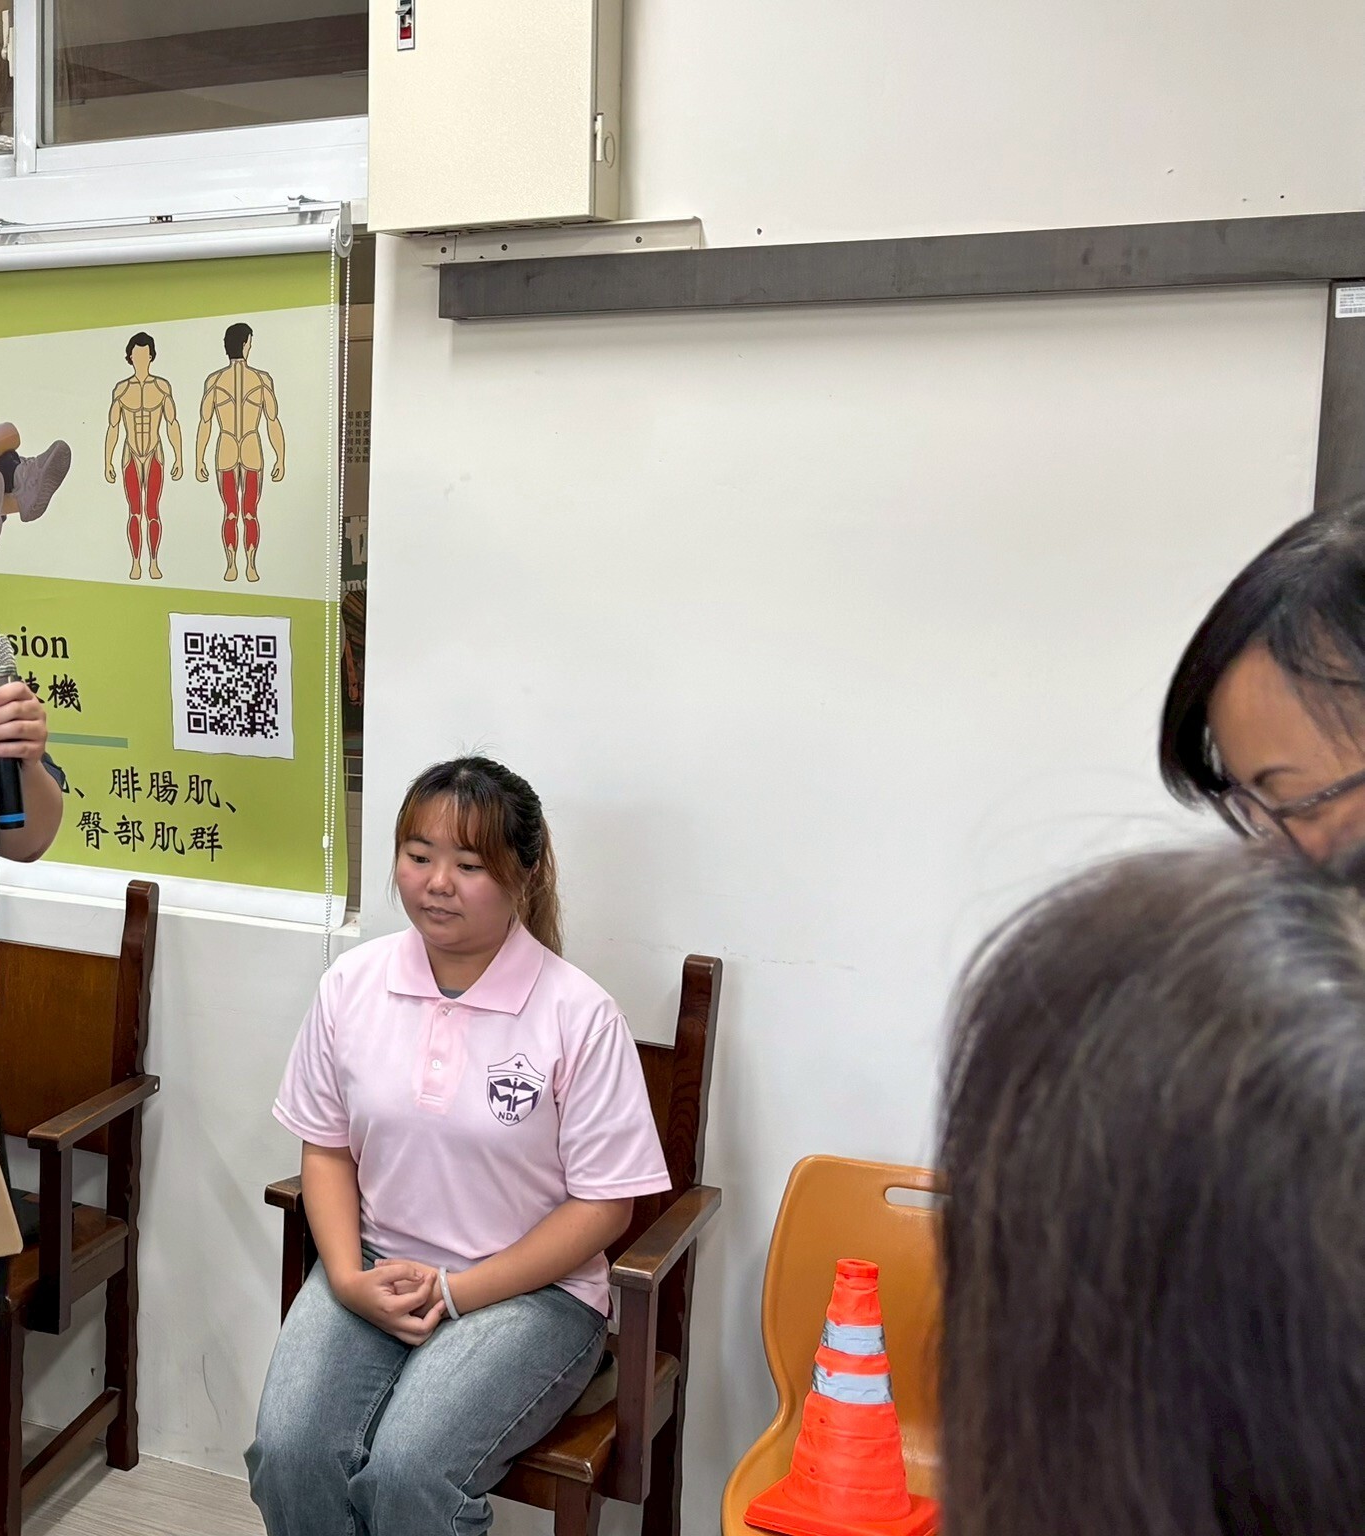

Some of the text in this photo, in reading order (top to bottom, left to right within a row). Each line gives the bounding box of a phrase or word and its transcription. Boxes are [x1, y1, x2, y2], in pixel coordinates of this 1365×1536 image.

[76, 811, 223, 862] 臀部肌群
[498, 1111, 521, 1122] NDA
